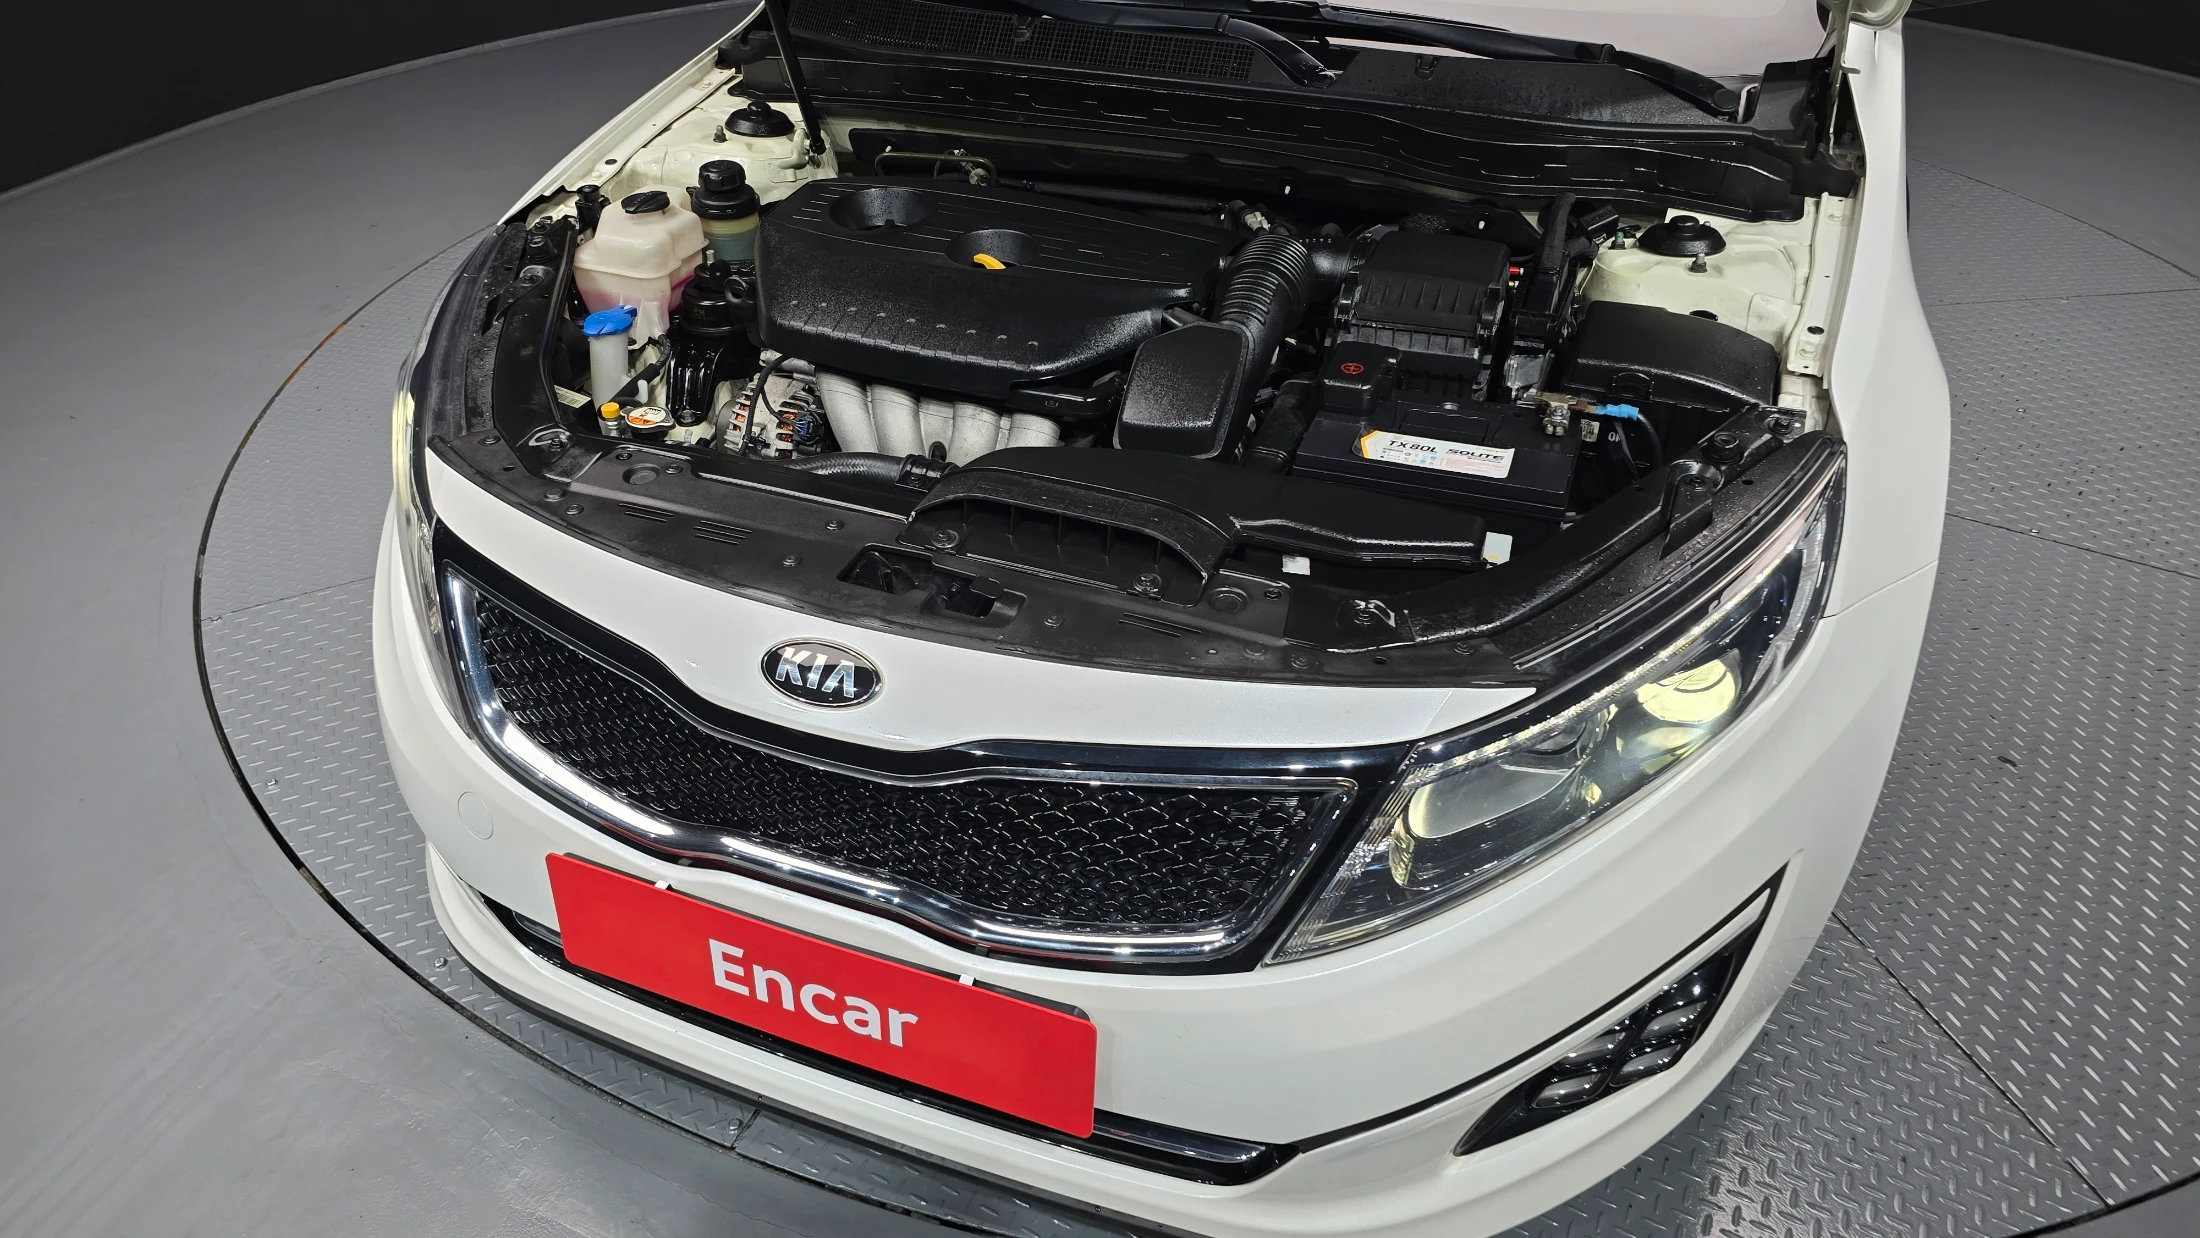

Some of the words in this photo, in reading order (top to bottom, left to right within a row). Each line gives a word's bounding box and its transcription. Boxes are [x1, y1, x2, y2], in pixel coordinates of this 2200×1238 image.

[1446, 448, 1505, 461] SOLITE
[775, 646, 856, 699] KIA
[708, 938, 919, 1048] Encar
